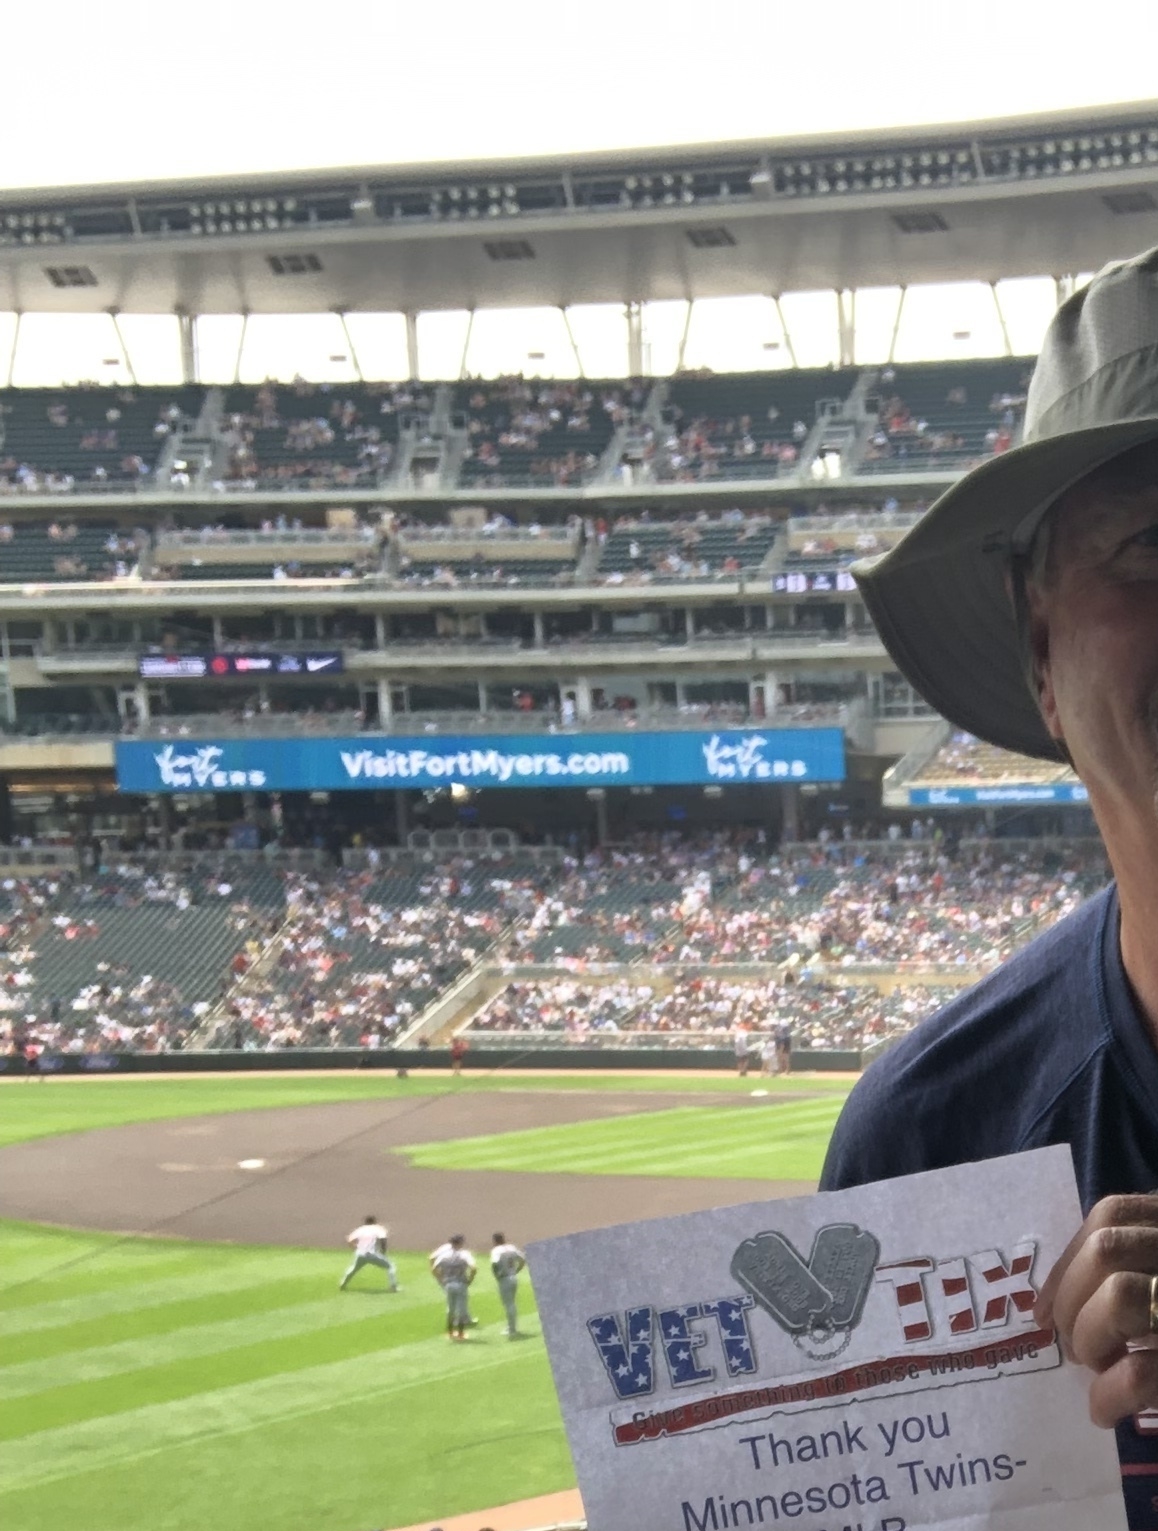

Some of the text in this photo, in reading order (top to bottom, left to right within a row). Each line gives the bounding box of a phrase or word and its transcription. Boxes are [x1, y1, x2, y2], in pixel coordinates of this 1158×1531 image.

[340, 749, 630, 782] VisitFortMyers.com
[875, 1241, 1038, 1345] TIX
[587, 1294, 757, 1400] VET
[632, 1340, 1039, 1432] Give something to those who gave
[739, 1412, 951, 1470] Thank you
[897, 1452, 1028, 1496] Twins-
